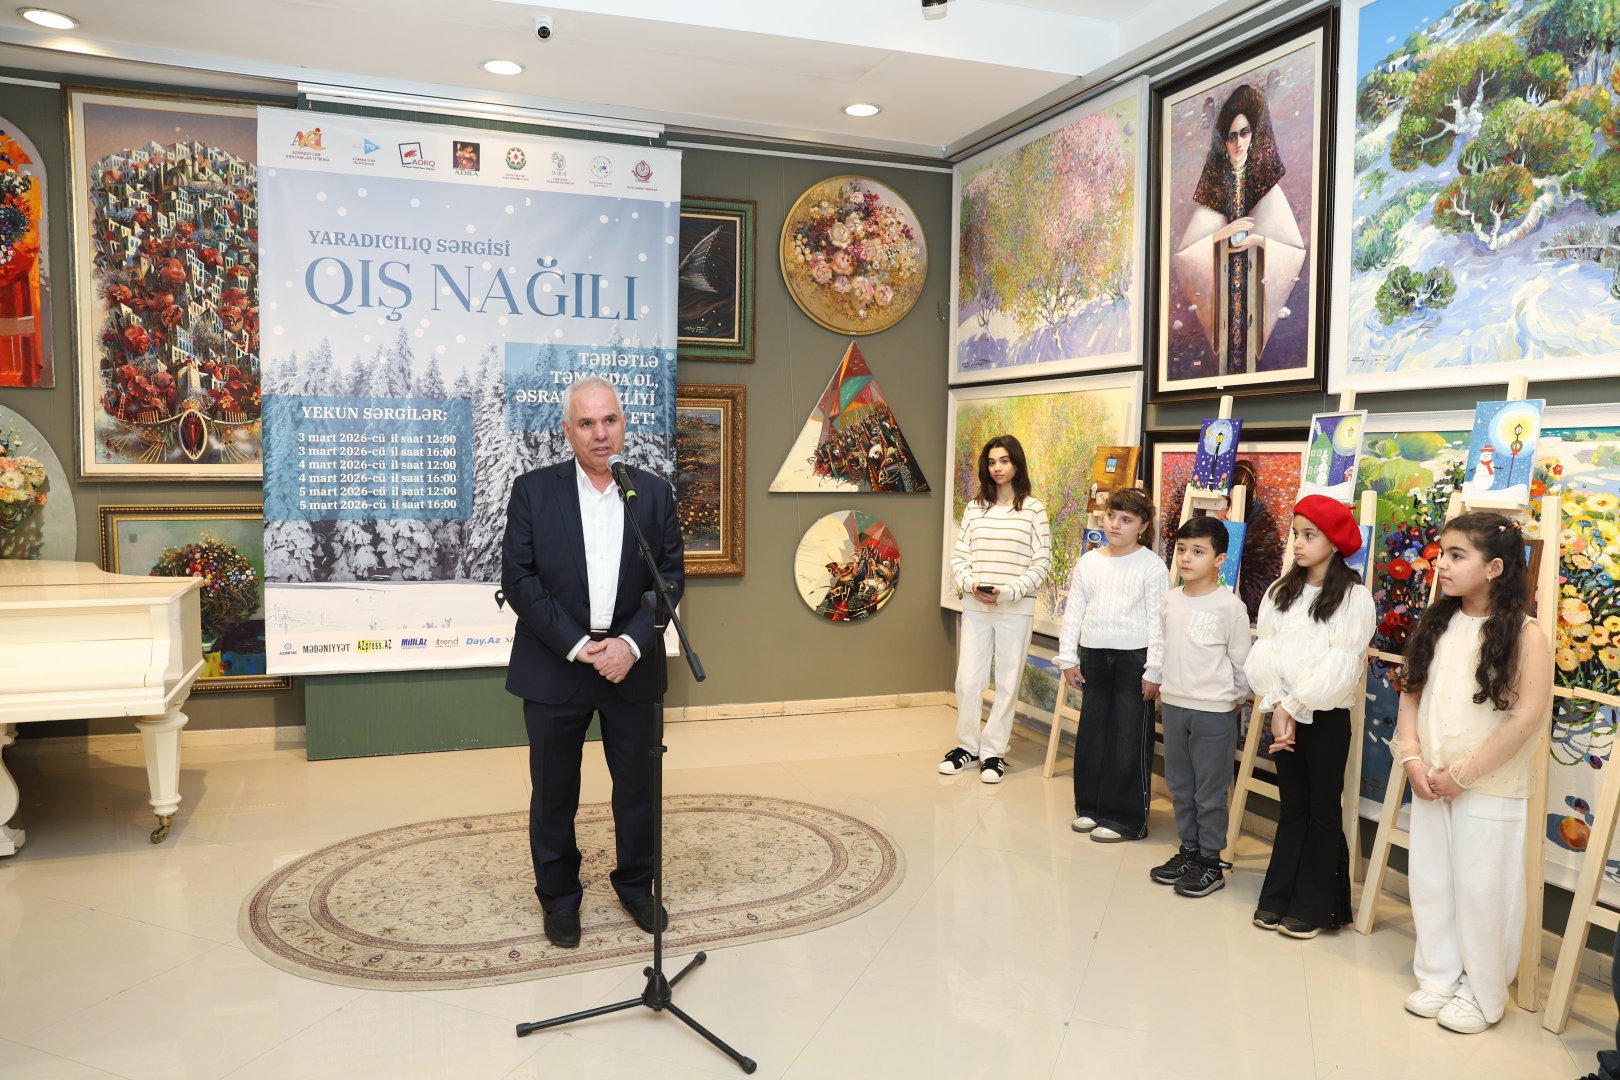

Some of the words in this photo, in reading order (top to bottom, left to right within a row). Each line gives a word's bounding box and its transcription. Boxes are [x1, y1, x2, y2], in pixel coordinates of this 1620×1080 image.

[308, 230, 432, 254] YARADICILIQ
[436, 238, 510, 256] SƏRGİSİ
[305, 257, 412, 321] QIŞ
[430, 258, 638, 321] NAĞILI
[578, 350, 658, 368] TƏBİƏTLƏ
[634, 374, 659, 388] OL,
[302, 406, 358, 419] YEKUN
[363, 405, 448, 421] SƏRGİLƏR:
[630, 411, 655, 425] ET!
[298, 433, 305, 442] 3
[340, 434, 385, 443] 2026-cü
[391, 434, 398, 443] il
[401, 435, 423, 443] saat
[427, 435, 456, 443] 12:00
[298, 447, 305, 455] 3
[309, 448, 336, 456] mart
[340, 447, 385, 456] 2026-cü
[391, 447, 398, 456] il
[401, 448, 423, 456] saat
[427, 448, 456, 457] 16:00
[299, 460, 305, 469] 4
[340, 460, 385, 469] 2026-cü
[391, 460, 398, 469] il
[401, 461, 423, 470] saat
[427, 461, 456, 470] 12:00
[299, 474, 305, 482] 4
[340, 474, 385, 482] 2026-cü
[391, 474, 398, 482] il
[401, 475, 423, 483] saat
[427, 474, 456, 483] 16:00
[299, 487, 305, 496] 5
[309, 488, 337, 496] mart
[340, 487, 386, 496] 2026-cü
[391, 487, 398, 495] il
[401, 488, 423, 496] saat
[427, 487, 456, 495] 12:00
[299, 501, 305, 510] 5
[340, 500, 386, 509] 2026-cü
[391, 500, 398, 508] il
[427, 500, 456, 508] 16:00
[358, 639, 392, 652] AZpress.AZ
[401, 638, 427, 646] Milli.Az
[436, 637, 458, 645] trend
[466, 637, 500, 646] Day.Az
